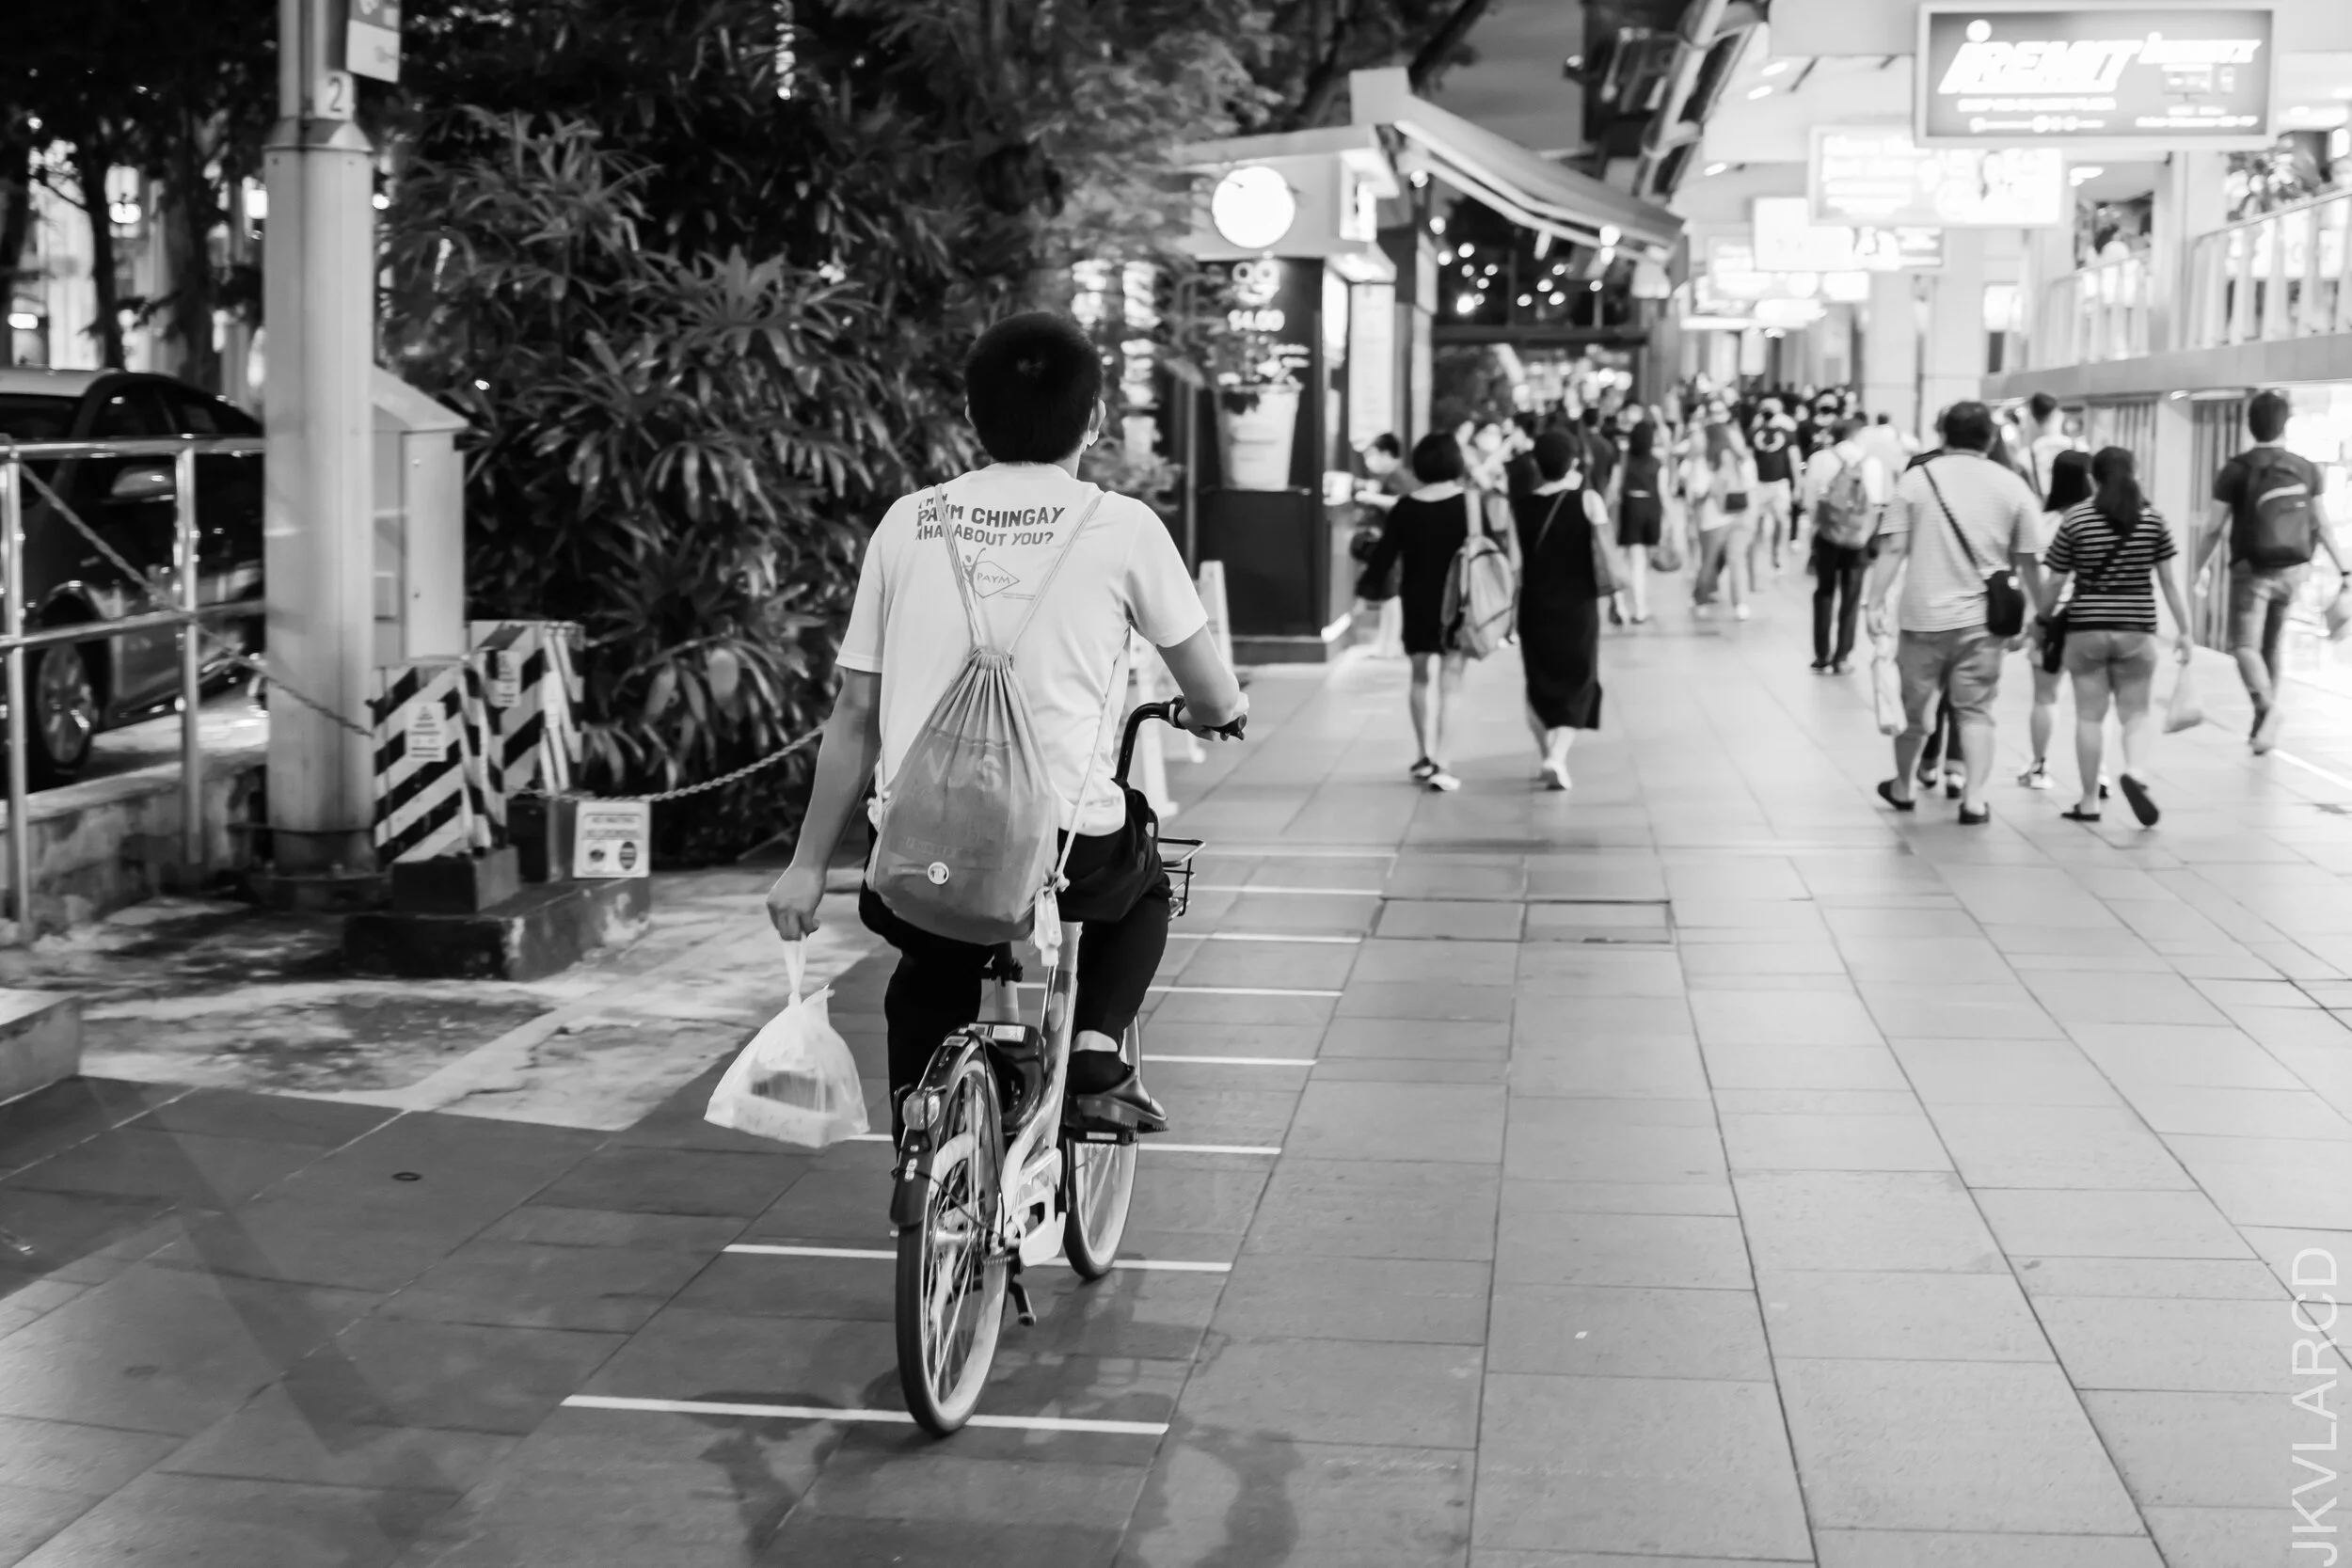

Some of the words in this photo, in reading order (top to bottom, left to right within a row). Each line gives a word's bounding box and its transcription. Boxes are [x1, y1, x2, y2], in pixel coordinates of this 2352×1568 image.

[917, 503, 963, 527] PAM
[971, 506, 1065, 528] CHINGAY
[954, 523, 1008, 546] ABOUT
[1011, 531, 1054, 546] YOU?
[977, 572, 1010, 584] PAYM
